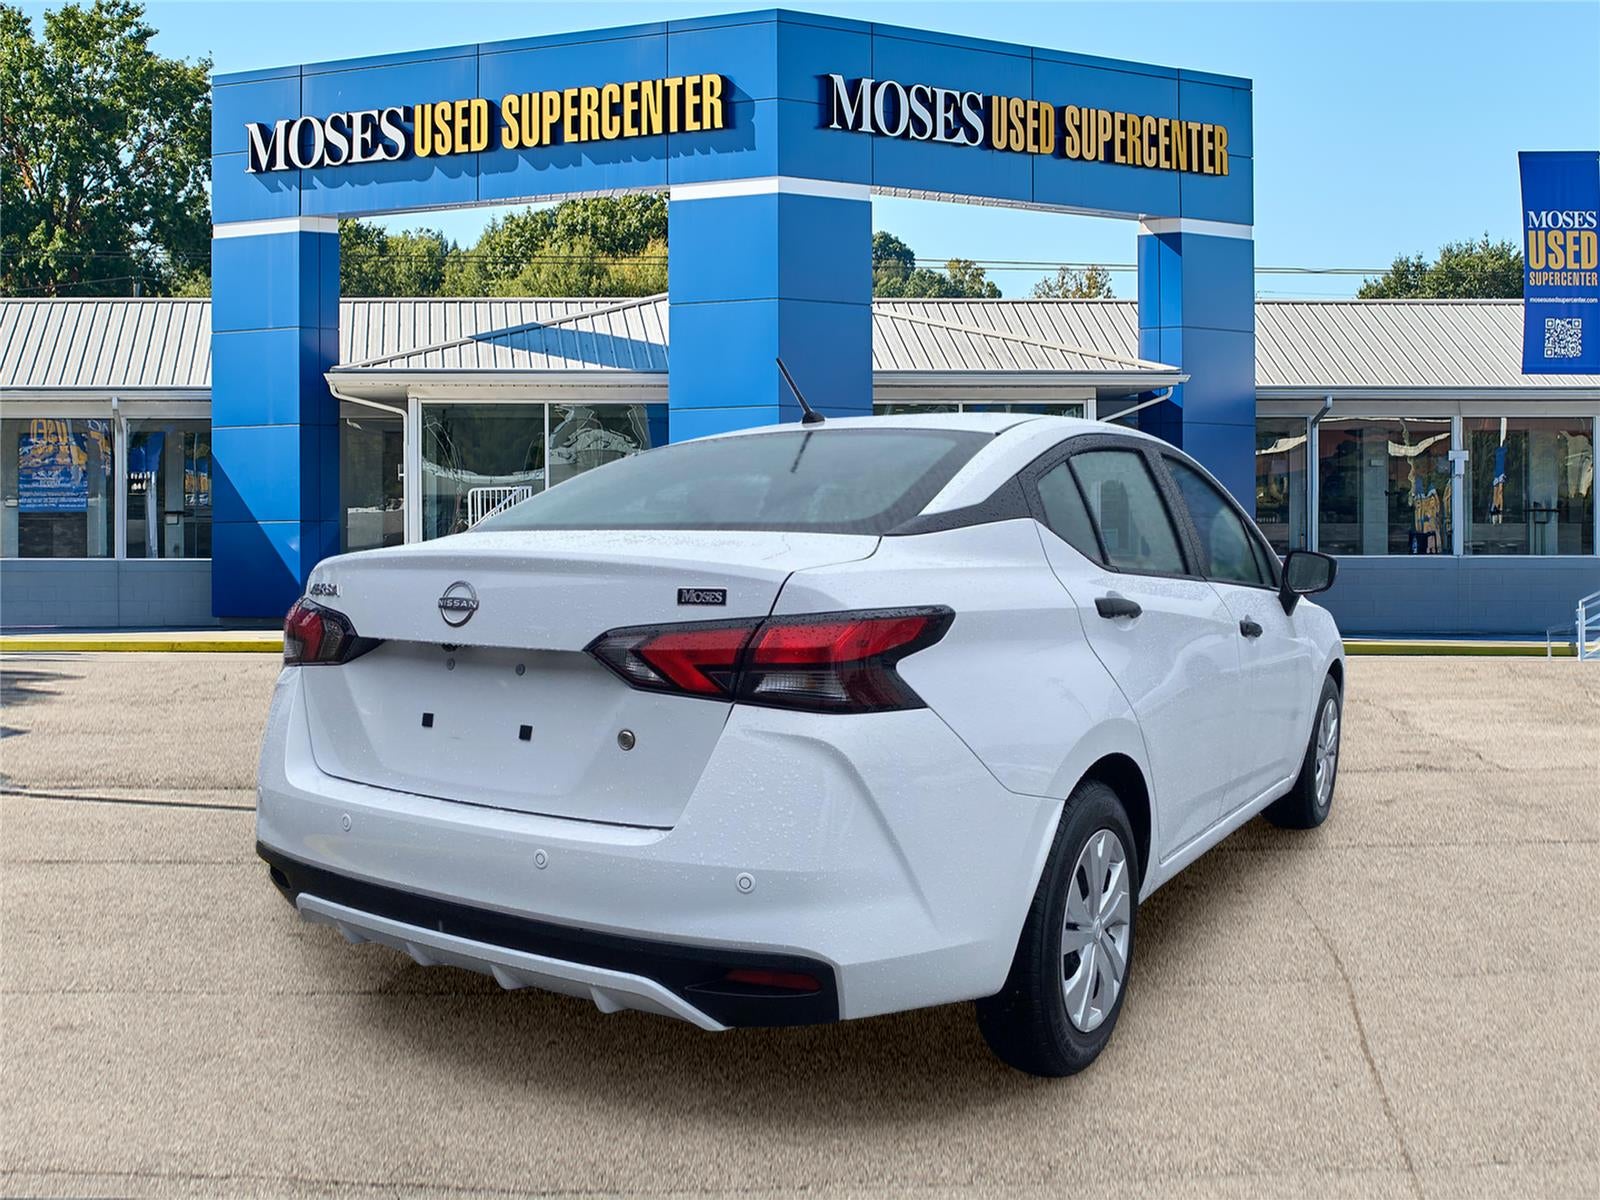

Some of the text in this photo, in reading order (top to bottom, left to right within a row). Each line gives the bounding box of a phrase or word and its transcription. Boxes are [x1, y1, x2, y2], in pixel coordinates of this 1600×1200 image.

[245, 73, 725, 174] MOSES USED SUPERCENTER
[828, 73, 1230, 176] MOSES USED SUPERCENTER
[1527, 210, 1597, 229] MOSES
[1528, 230, 1599, 270] USED
[1529, 271, 1598, 287] SUPERCENTER
[439, 599, 478, 609] NISSAN
[681, 589, 723, 603] MOSES
